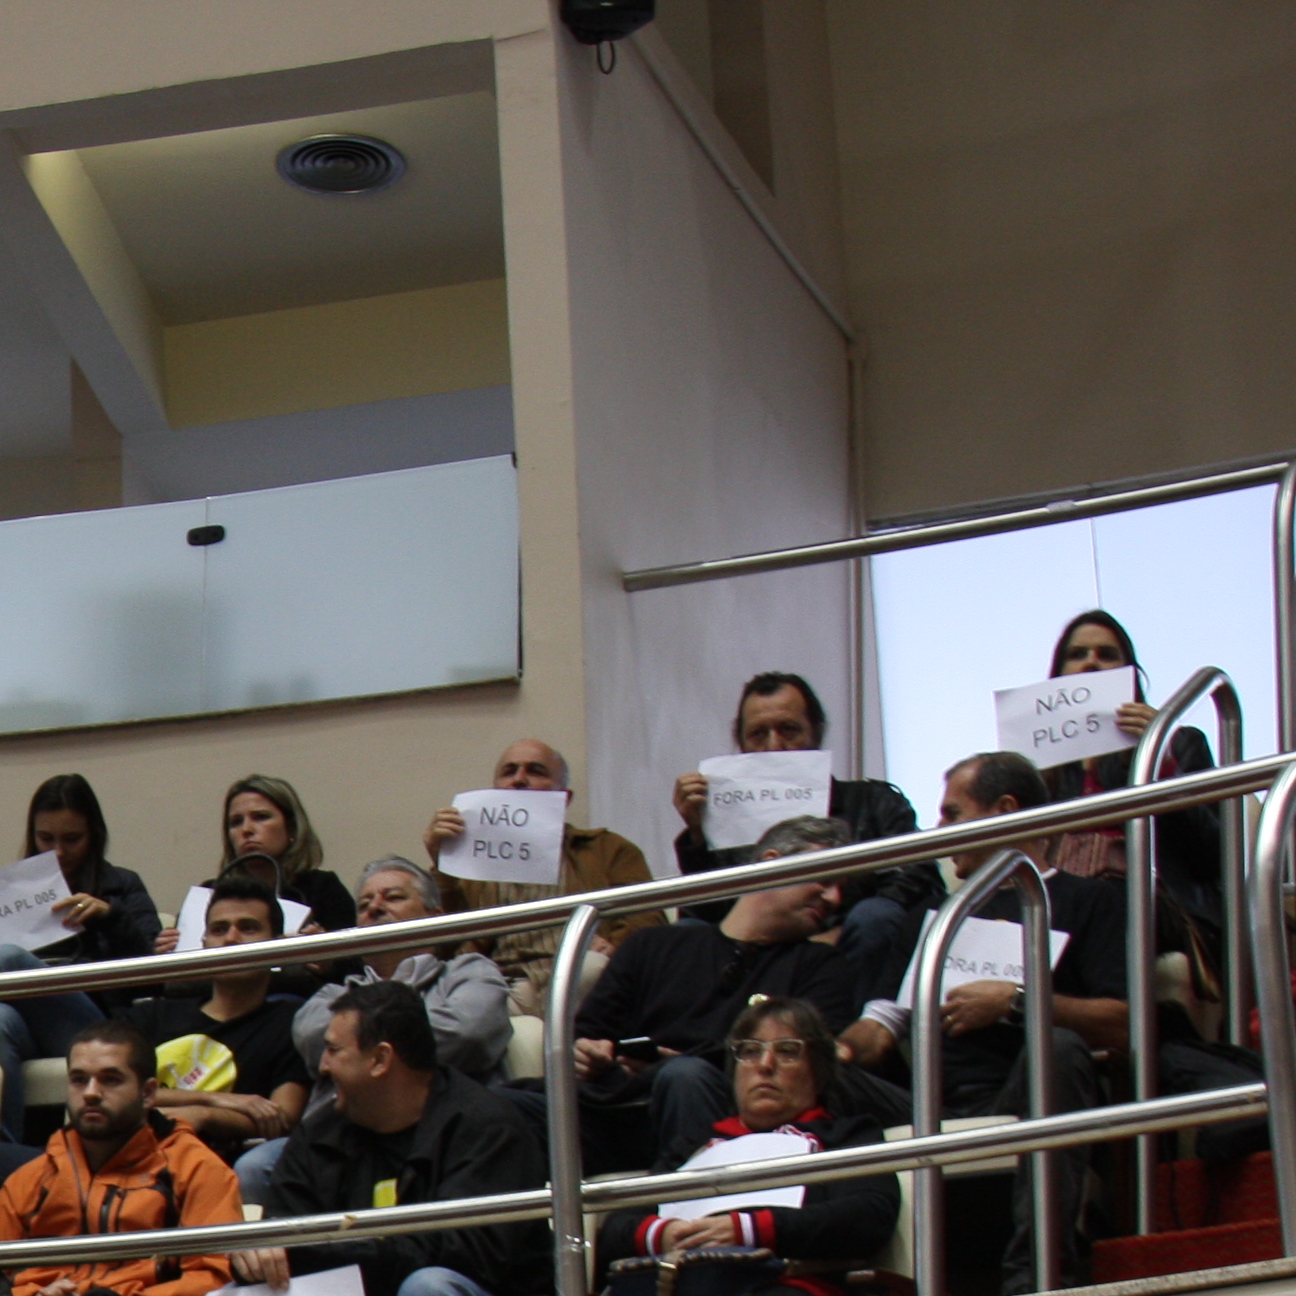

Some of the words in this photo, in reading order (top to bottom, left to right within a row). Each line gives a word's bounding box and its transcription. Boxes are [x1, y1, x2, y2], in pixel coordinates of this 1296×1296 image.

[1037, 687, 1090, 715] NÃO
[1033, 721, 1079, 747] PLC
[1087, 715, 1100, 732] 5
[714, 789, 754, 806] FORA
[760, 789, 779, 801] PL
[785, 787, 812, 799] 005
[480, 803, 528, 826] NÃO
[473, 840, 514, 860] PLC
[519, 842, 530, 860] 5
[15, 899, 33, 911] PL
[35, 889, 56, 904] 005
[982, 961, 997, 975] PL
